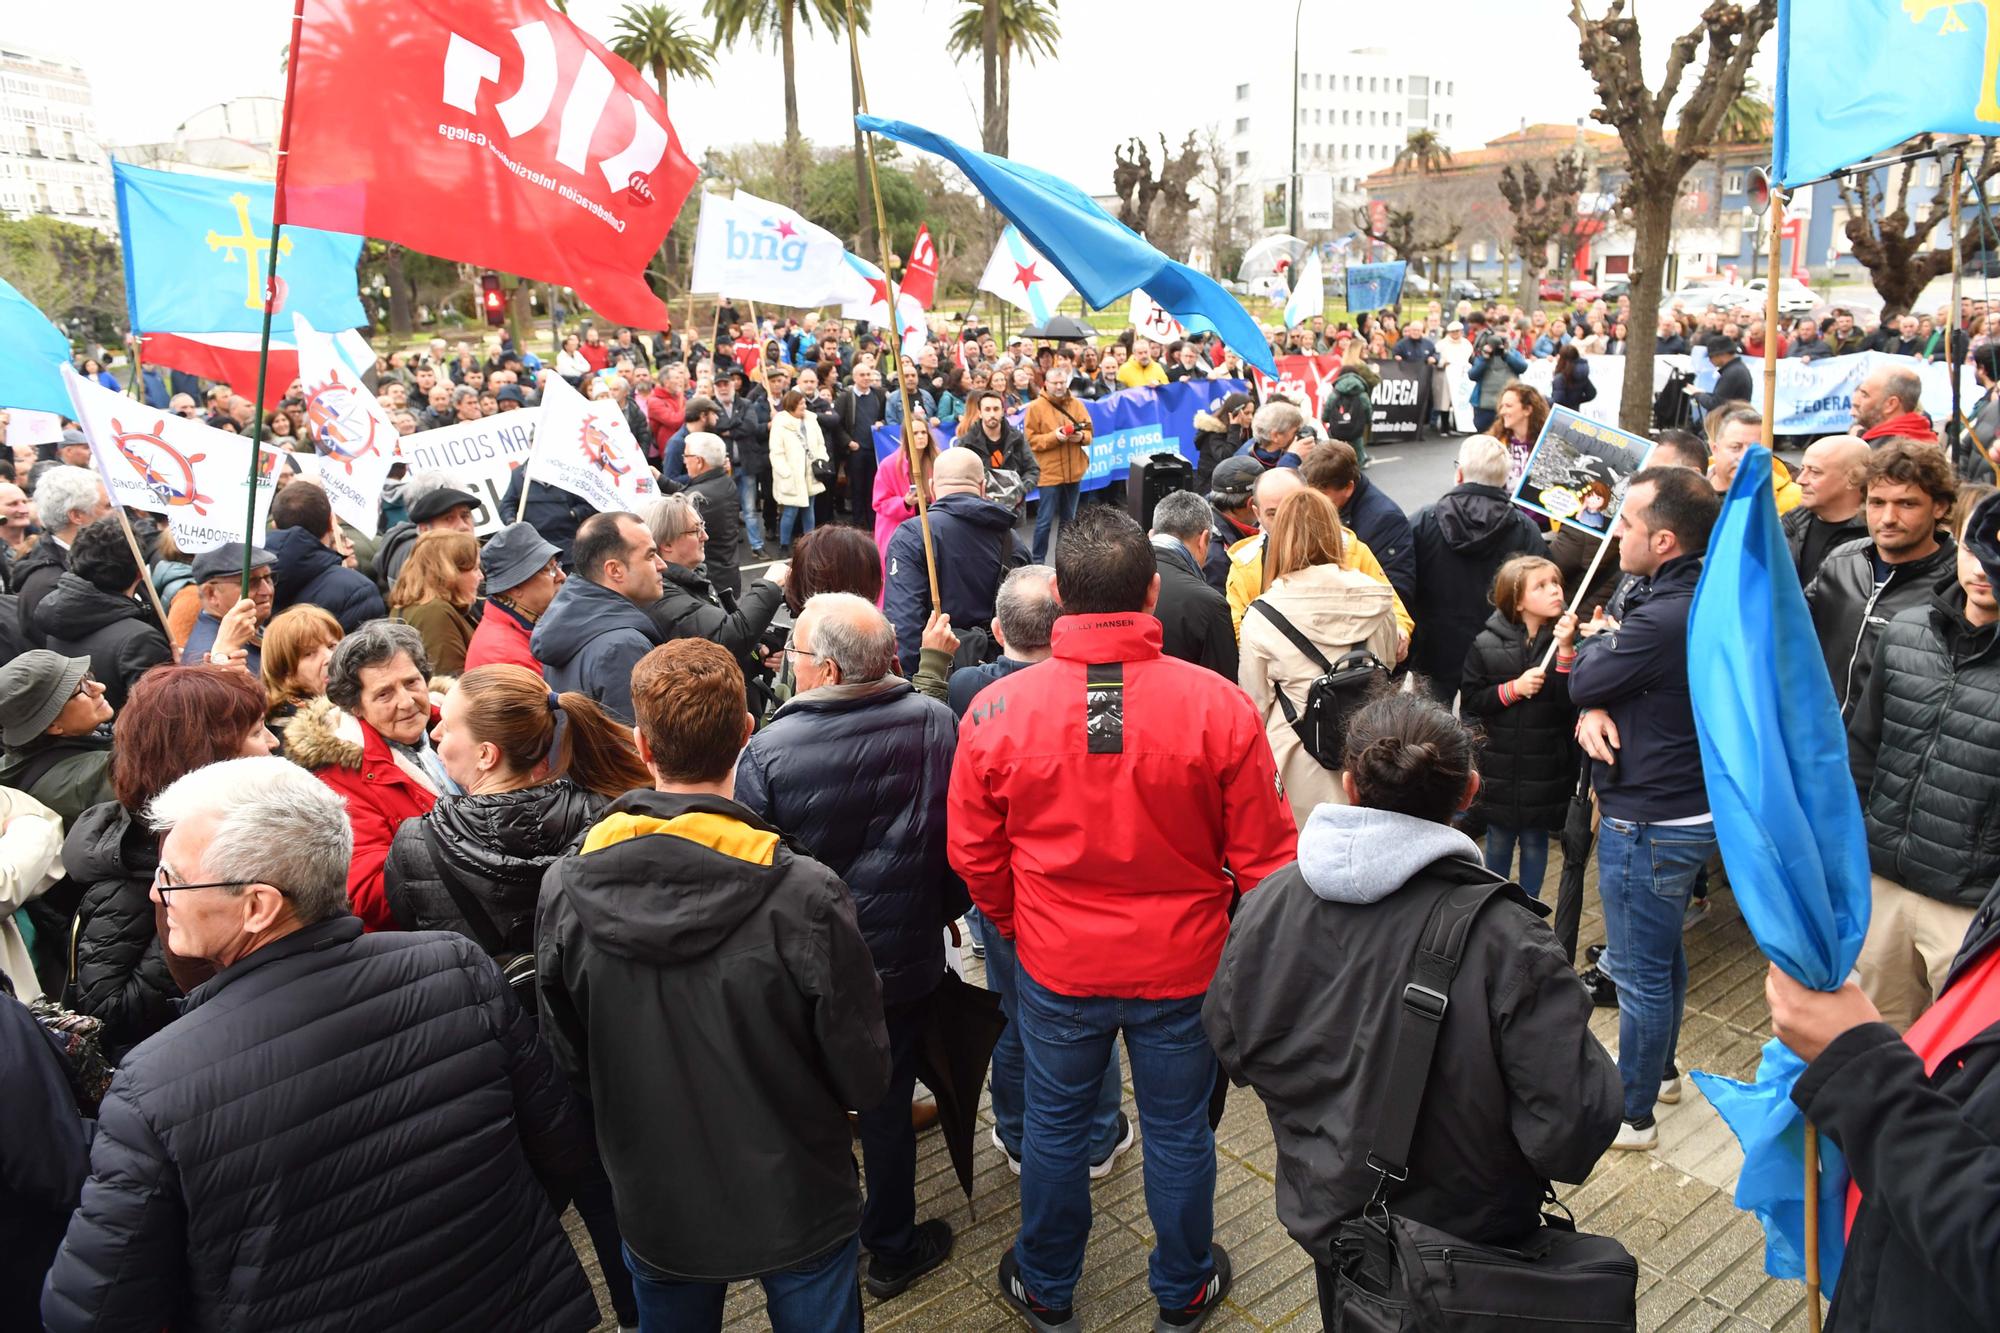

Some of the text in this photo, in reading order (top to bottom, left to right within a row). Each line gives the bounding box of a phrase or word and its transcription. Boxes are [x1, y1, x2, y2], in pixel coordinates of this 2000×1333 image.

[725, 219, 808, 272] bng
[1371, 379, 1419, 406] ADEGA
[1794, 395, 1852, 415] FEDERA
[1130, 431, 1161, 448] noso
[1095, 619, 1134, 629] HANSEN
[972, 696, 1005, 726] HH
